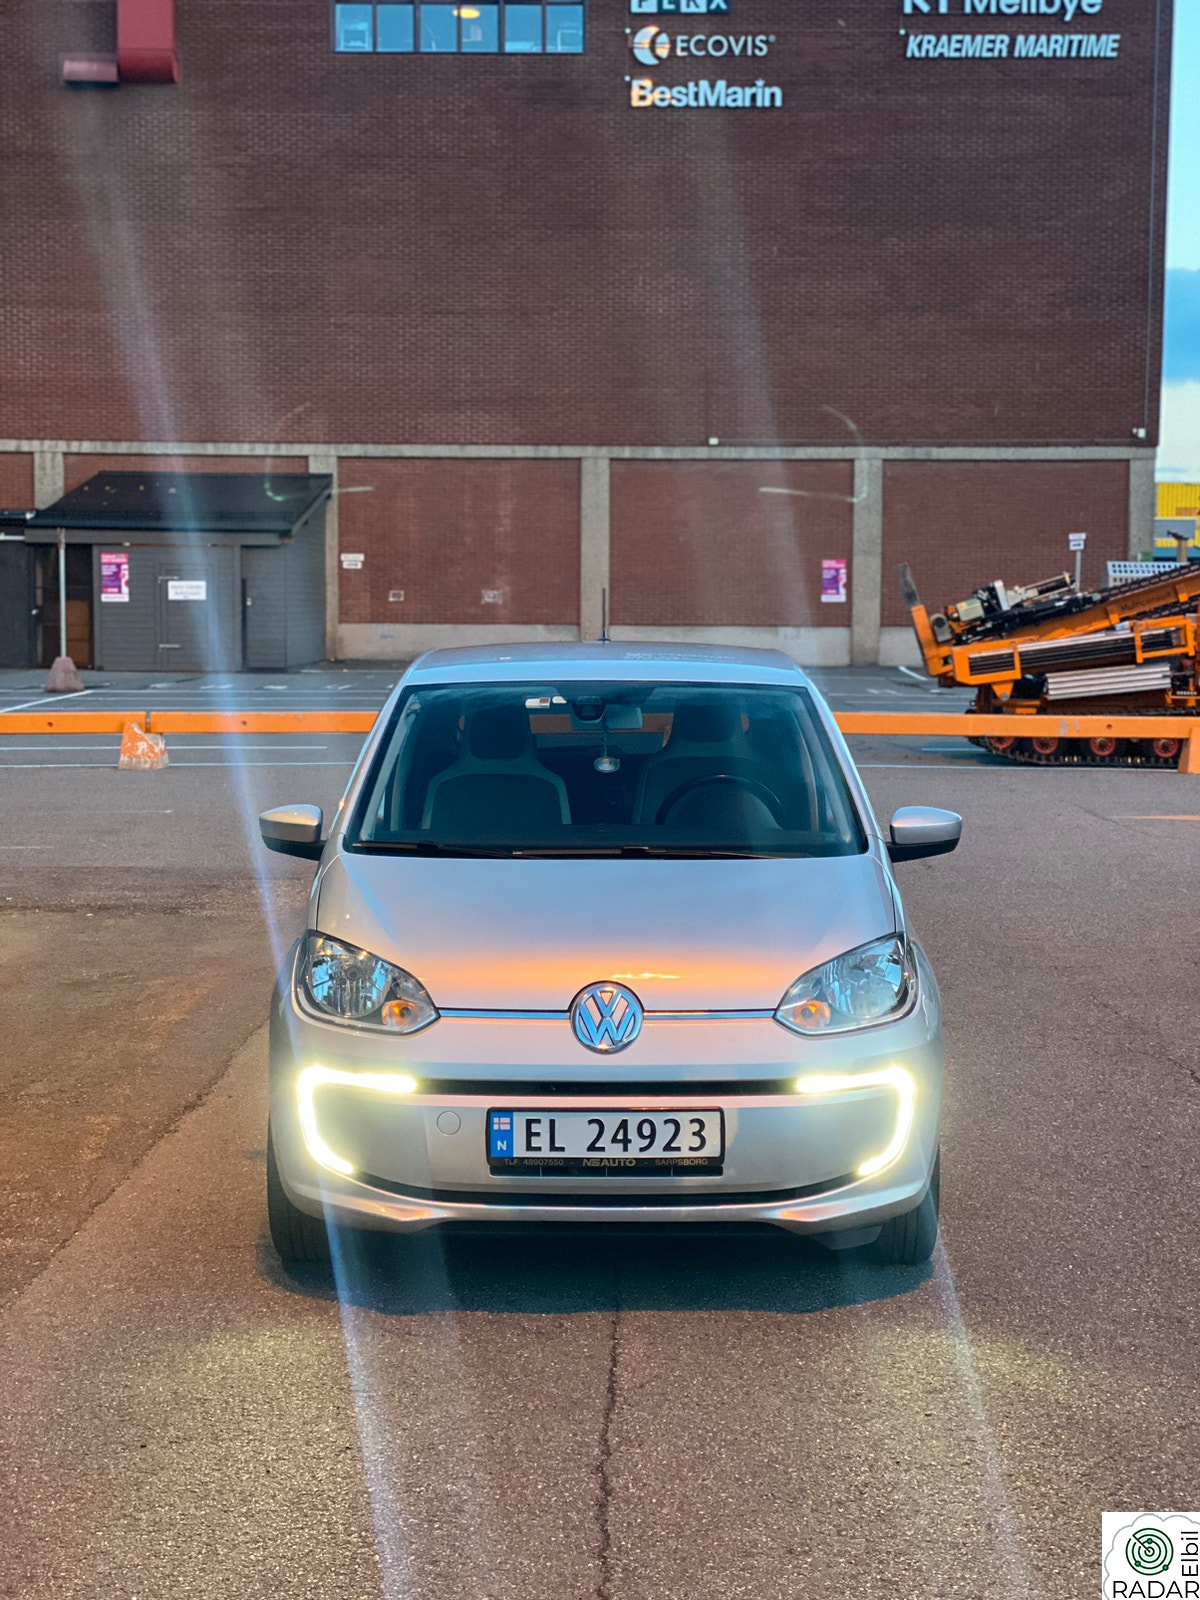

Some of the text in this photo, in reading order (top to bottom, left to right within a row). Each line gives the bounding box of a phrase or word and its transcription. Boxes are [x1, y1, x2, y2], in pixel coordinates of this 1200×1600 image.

[906, 34, 1121, 58] KRAEMER MARITIME
[631, 79, 783, 108] BestMarin
[497, 1140, 507, 1151] N
[525, 1118, 707, 1153] EL 24923
[655, 1158, 708, 1167] SARPSBORG
